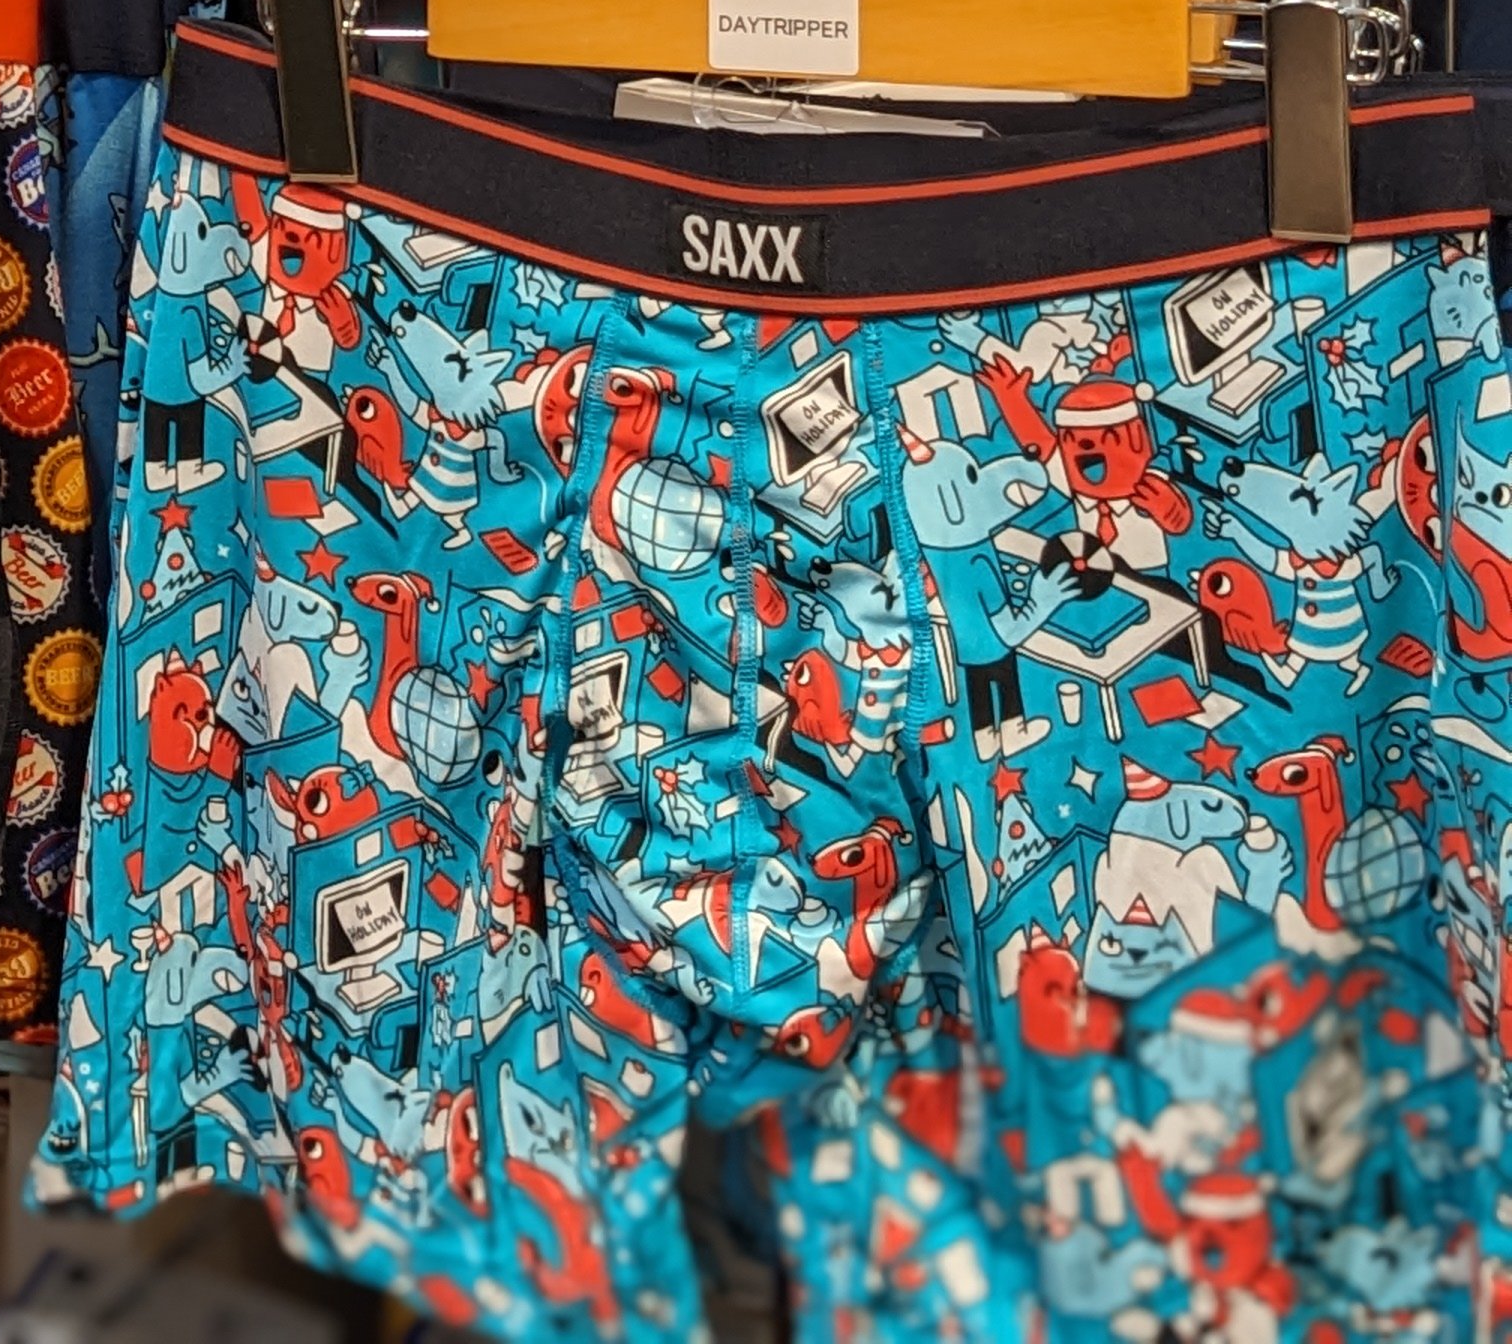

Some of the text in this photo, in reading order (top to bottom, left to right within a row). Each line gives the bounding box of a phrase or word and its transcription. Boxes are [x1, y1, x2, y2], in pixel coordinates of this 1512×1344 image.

[718, 14, 850, 40] DAYTRIPPER
[682, 214, 804, 283] SAXX
[1205, 288, 1265, 342] HOLIDAY
[1211, 288, 1233, 311] ON
[799, 399, 852, 447] HOLIDAY
[802, 399, 822, 421] ON
[3, 552, 46, 590] Beer
[14, 760, 37, 787] eer
[347, 906, 399, 943] HOLIDAY
[355, 900, 373, 921] ON
